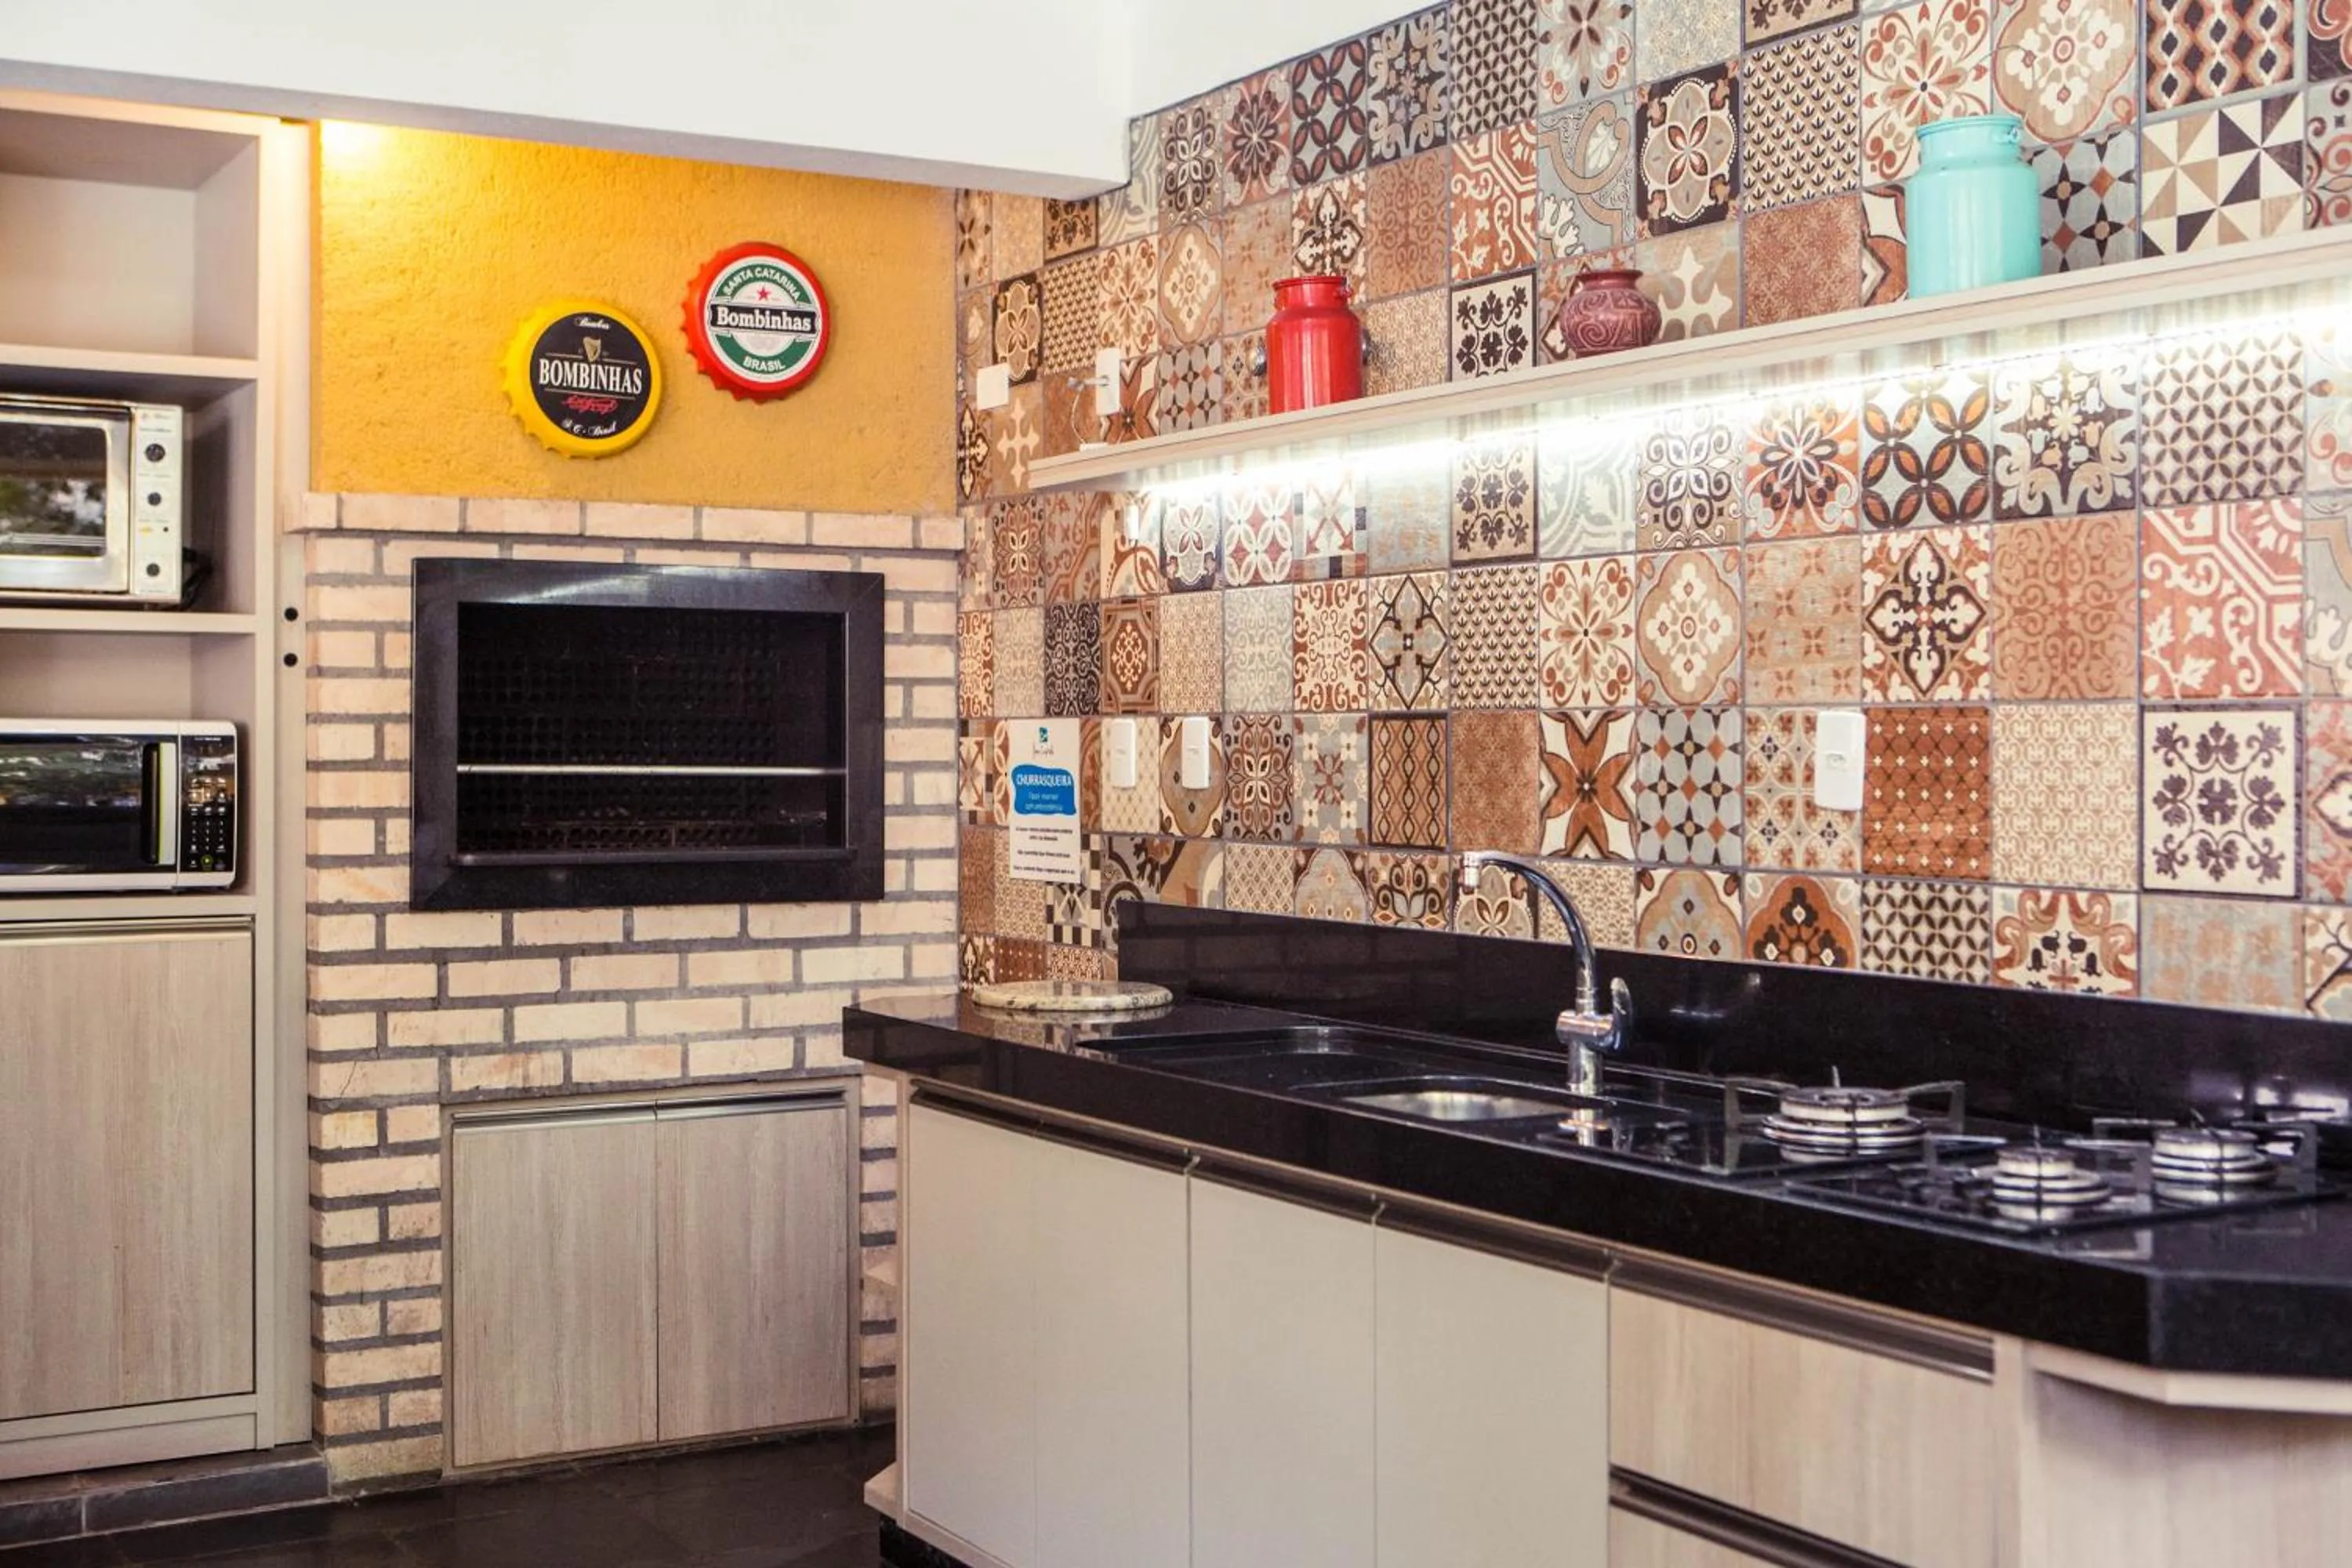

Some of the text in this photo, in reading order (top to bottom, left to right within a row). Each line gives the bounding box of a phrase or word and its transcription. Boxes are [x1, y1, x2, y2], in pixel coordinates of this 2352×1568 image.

[723, 267, 800, 300] SANTA CATARINA
[716, 306, 811, 332] Bombinhas
[539, 358, 642, 394] BOMBINHAS
[742, 355, 786, 372] BRASIL
[1015, 773, 1073, 787] CHURRASQUEIRA
